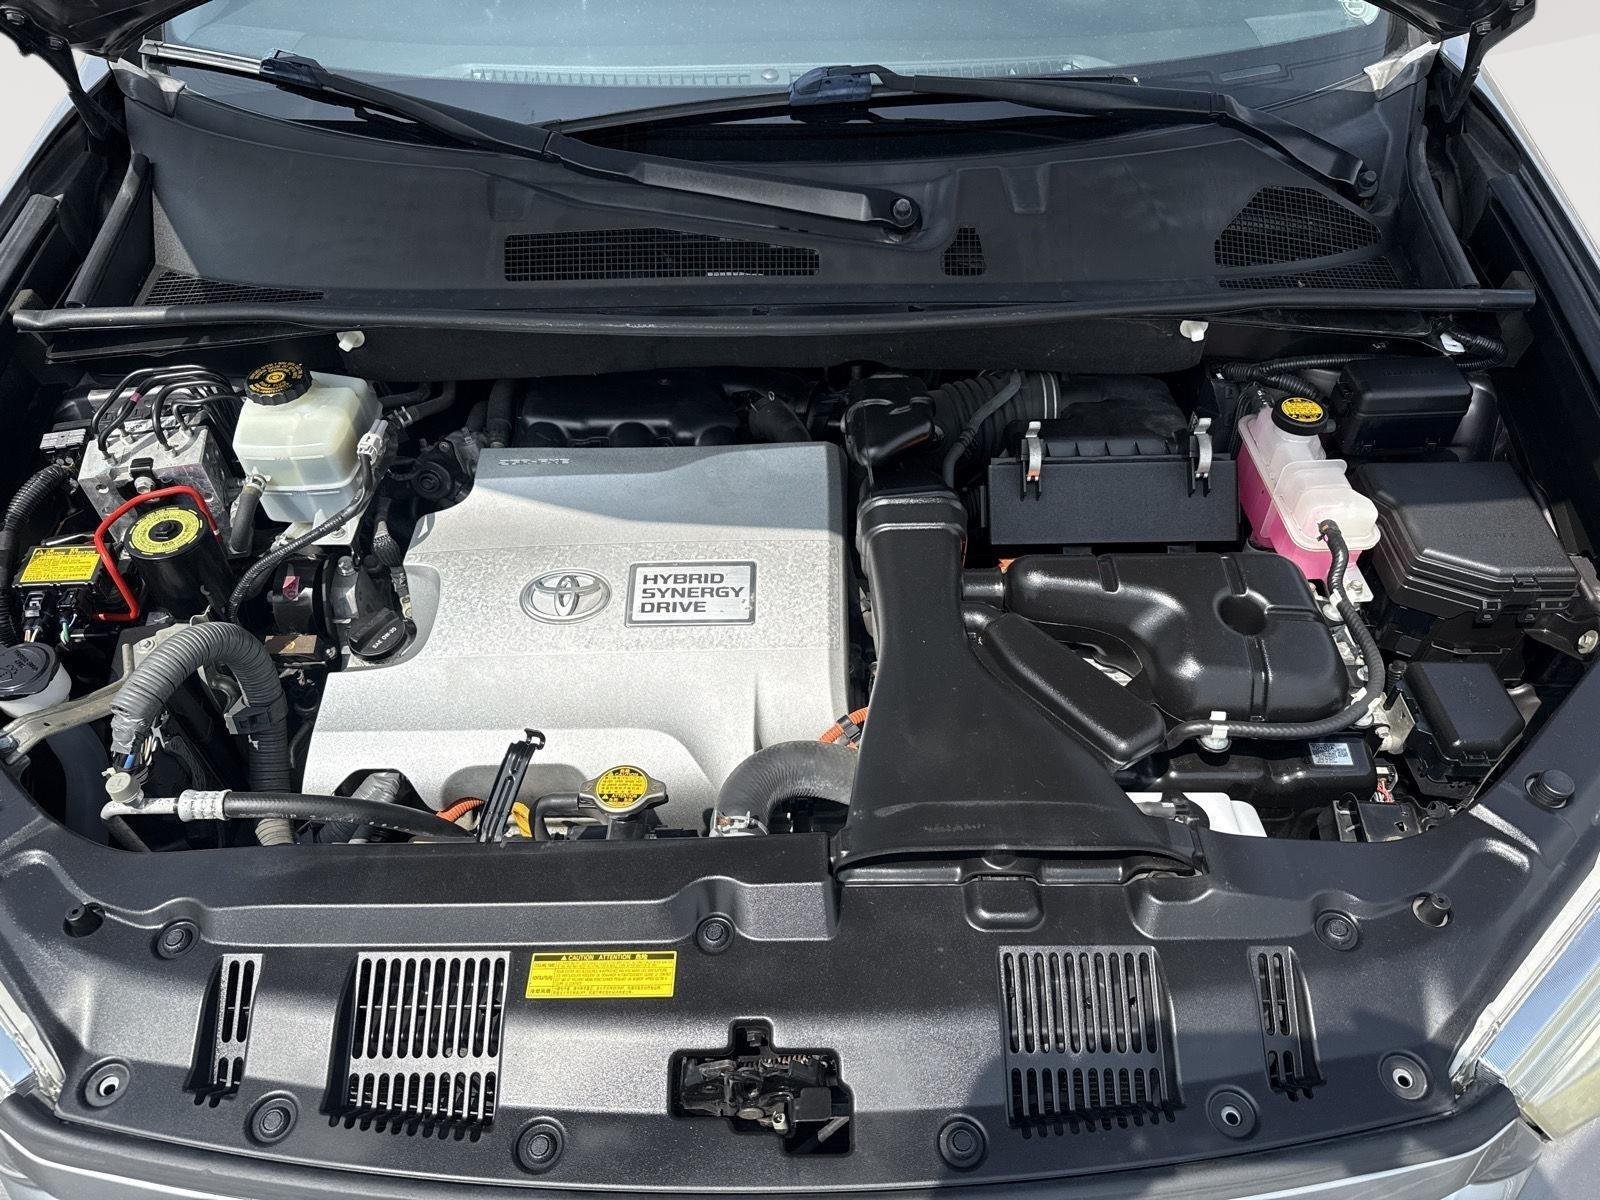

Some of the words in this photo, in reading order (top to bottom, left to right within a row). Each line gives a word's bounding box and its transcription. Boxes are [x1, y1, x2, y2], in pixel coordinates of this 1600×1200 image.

[642, 573, 725, 585] HYBRID
[641, 586, 745, 599] SYNERGY
[640, 601, 707, 613] DRIVE
